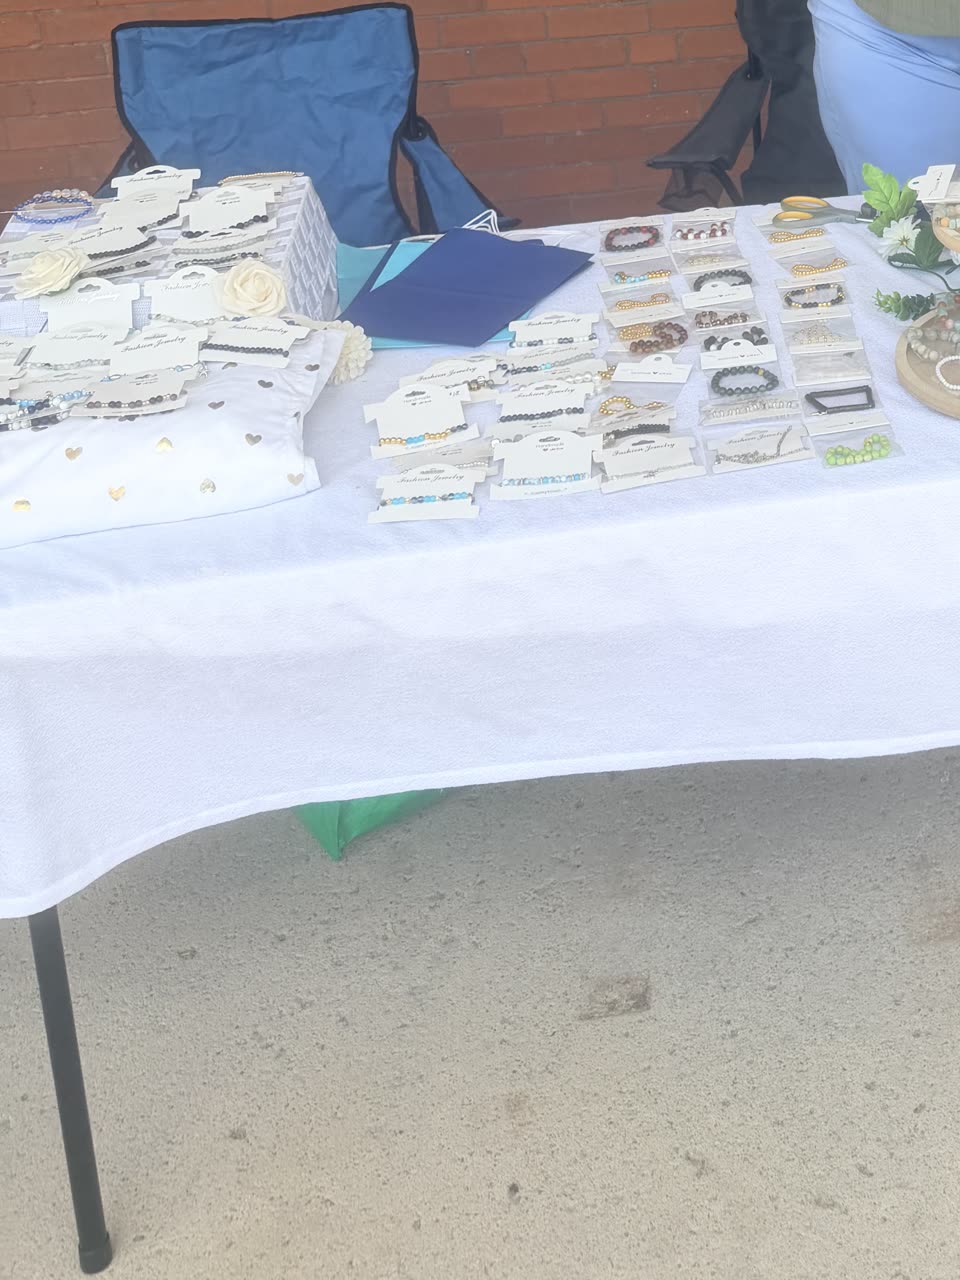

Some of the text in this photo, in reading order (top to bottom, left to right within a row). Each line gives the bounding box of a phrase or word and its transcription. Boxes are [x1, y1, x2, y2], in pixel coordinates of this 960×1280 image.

[120, 336, 186, 353] Fashion Jewelry
[416, 366, 478, 381] Fashion Jewelry
[612, 441, 675, 457] Fashion Jewelry
[397, 473, 465, 484] Fashion Jewelry
